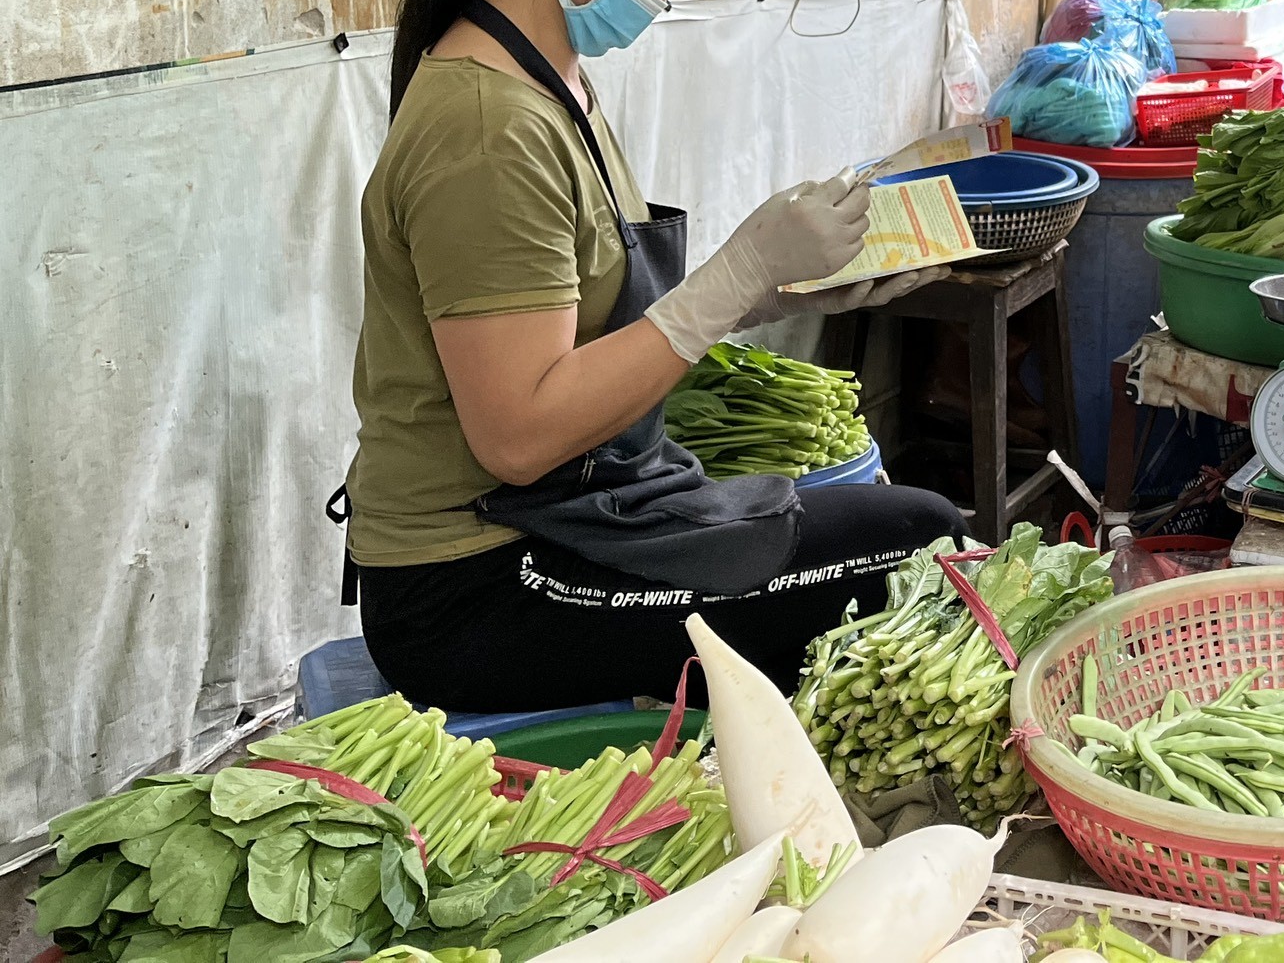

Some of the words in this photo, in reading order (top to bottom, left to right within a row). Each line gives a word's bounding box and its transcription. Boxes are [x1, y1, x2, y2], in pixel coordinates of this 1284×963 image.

[845, 559, 855, 568] TM
[856, 557, 872, 566] WILL
[875, 552, 895, 563] 5,400
[895, 549, 907, 558] lbs
[768, 563, 845, 593] OFF-WHITE
[553, 580, 570, 595] WILL
[593, 588, 607, 598] lbs
[611, 589, 694, 607] OFF-WHITE
